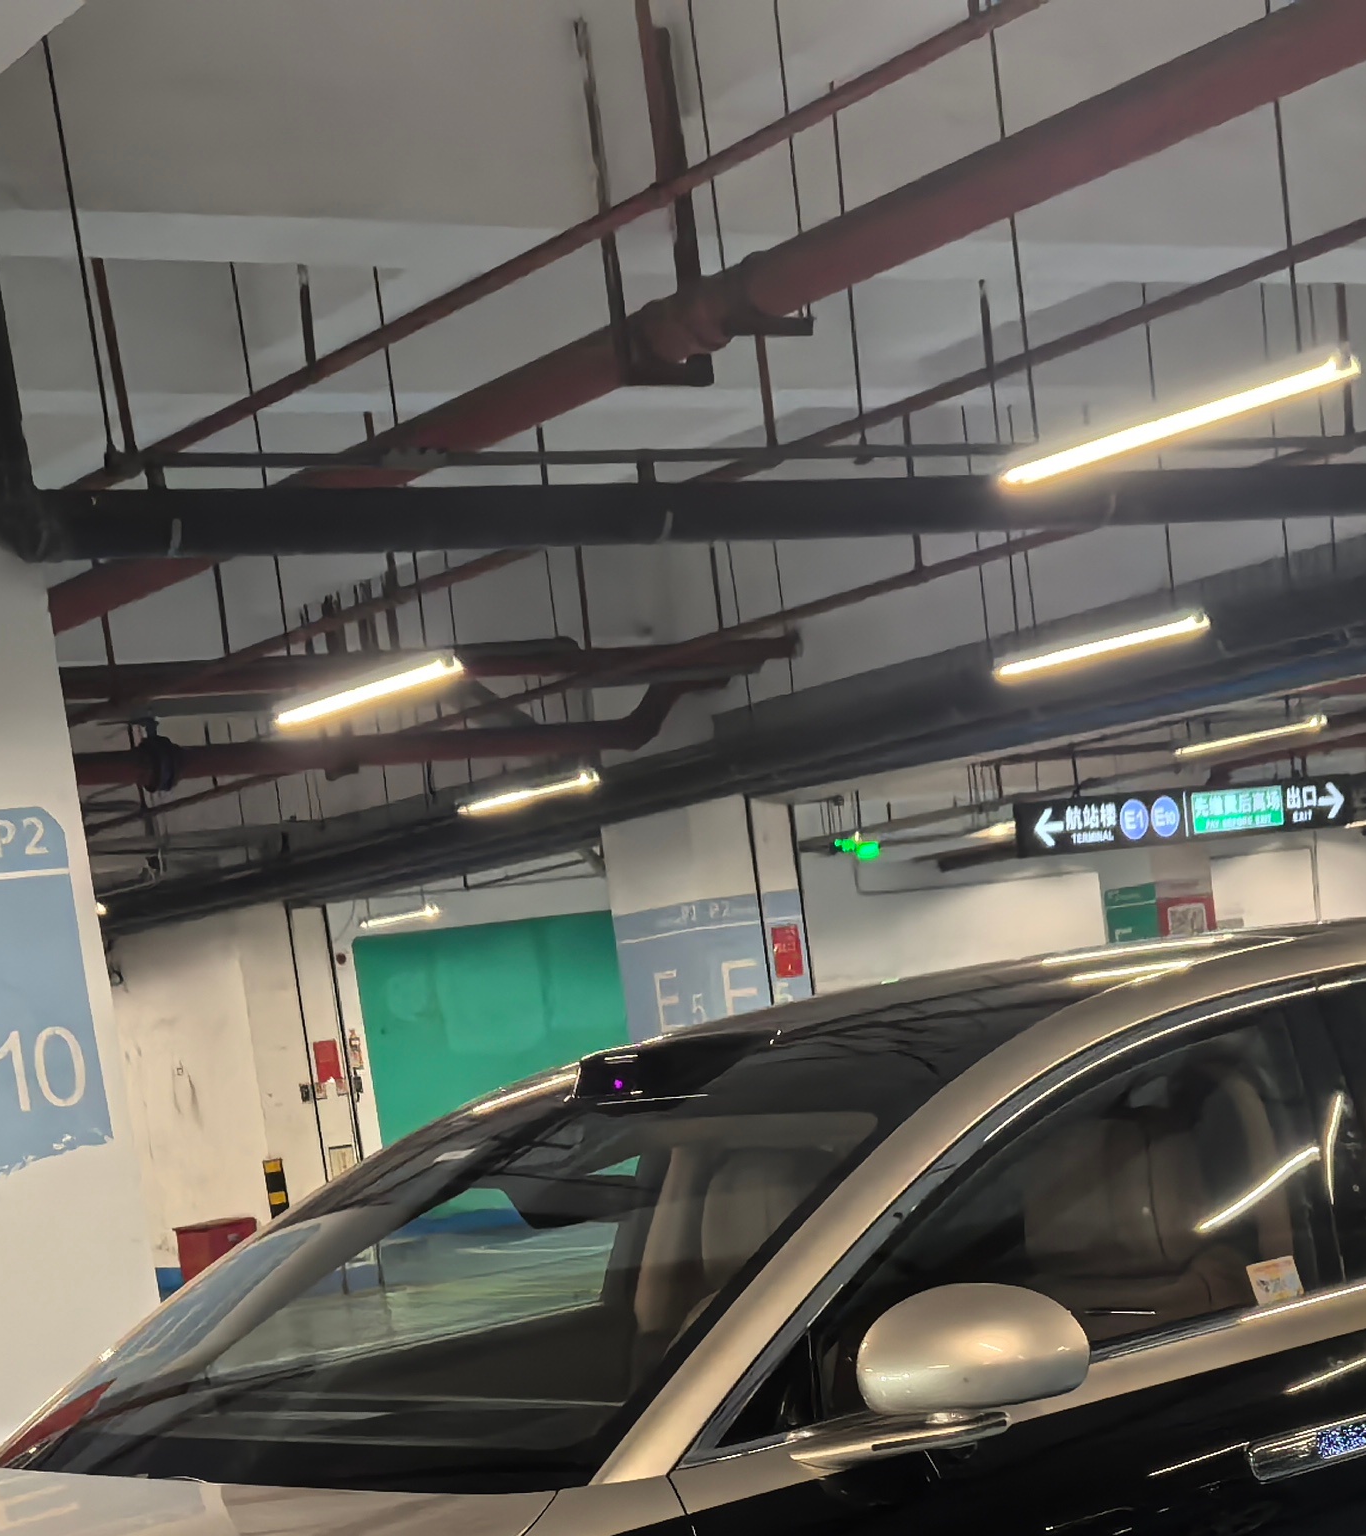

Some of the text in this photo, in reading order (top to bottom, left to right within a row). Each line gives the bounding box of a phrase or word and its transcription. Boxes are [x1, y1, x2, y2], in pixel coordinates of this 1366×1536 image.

[1286, 785, 1317, 809] 出口
[1065, 802, 1117, 831] 航站楼
[1123, 805, 1177, 831] E1 E10
[1292, 809, 1313, 823] EXIT
[1071, 829, 1115, 844] TERMINAL
